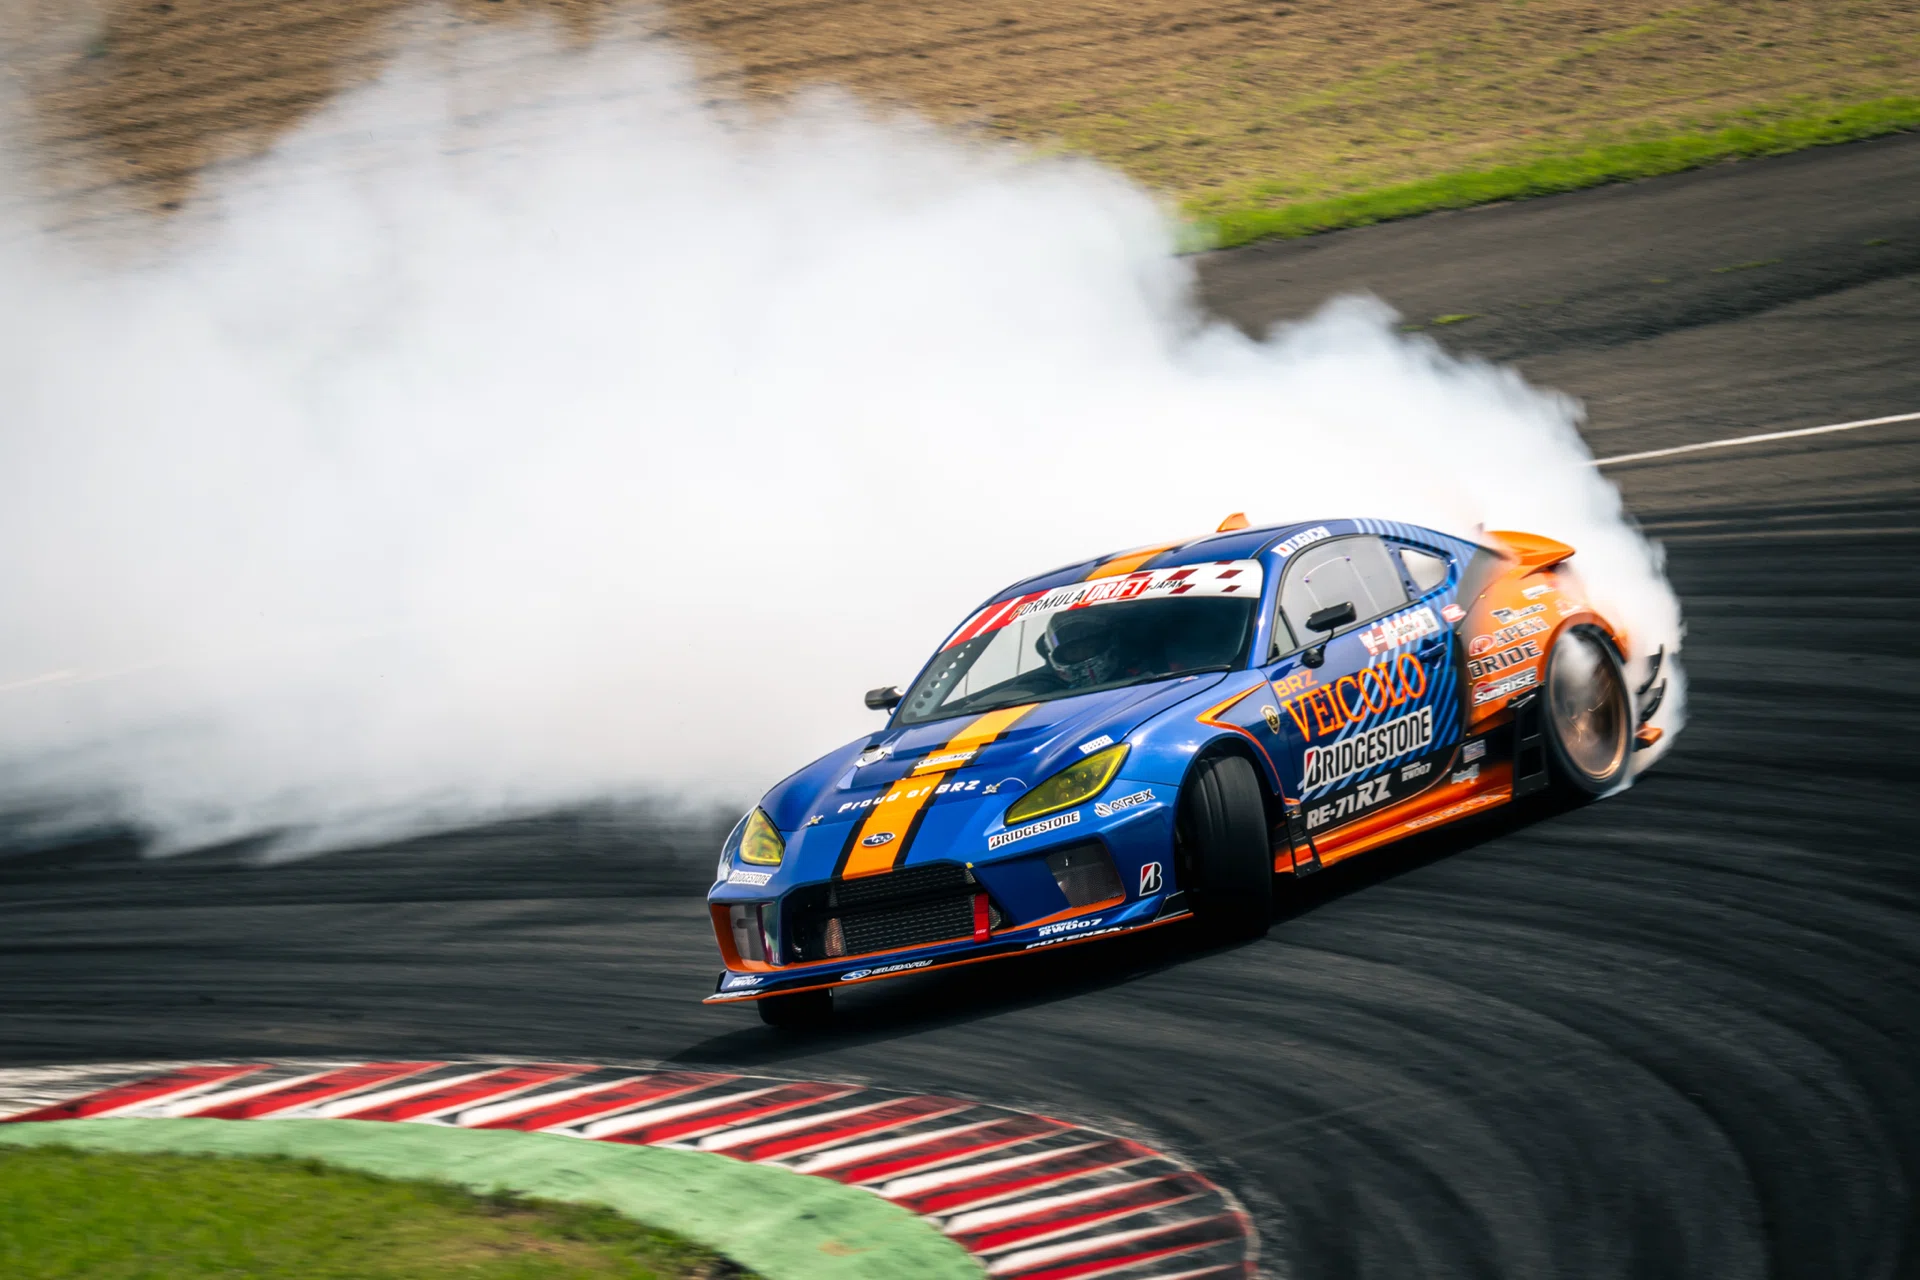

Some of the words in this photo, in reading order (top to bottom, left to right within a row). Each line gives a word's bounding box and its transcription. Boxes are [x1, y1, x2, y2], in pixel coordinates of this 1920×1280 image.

[1009, 590, 1084, 620] FORMULA
[1082, 579, 1150, 604] DRIFT
[1467, 640, 1543, 679] BRIDE
[1272, 669, 1319, 698] BRZ
[1281, 653, 1427, 742] VEICOLO
[1304, 706, 1432, 793] BRIDGESTONE
[837, 791, 901, 813] Proud
[906, 786, 932, 798] of
[935, 780, 981, 795] BRZ
[989, 812, 1079, 848] BRIDGESTONE
[1025, 926, 1122, 950] POTENZA
[1038, 917, 1103, 937] RW007
